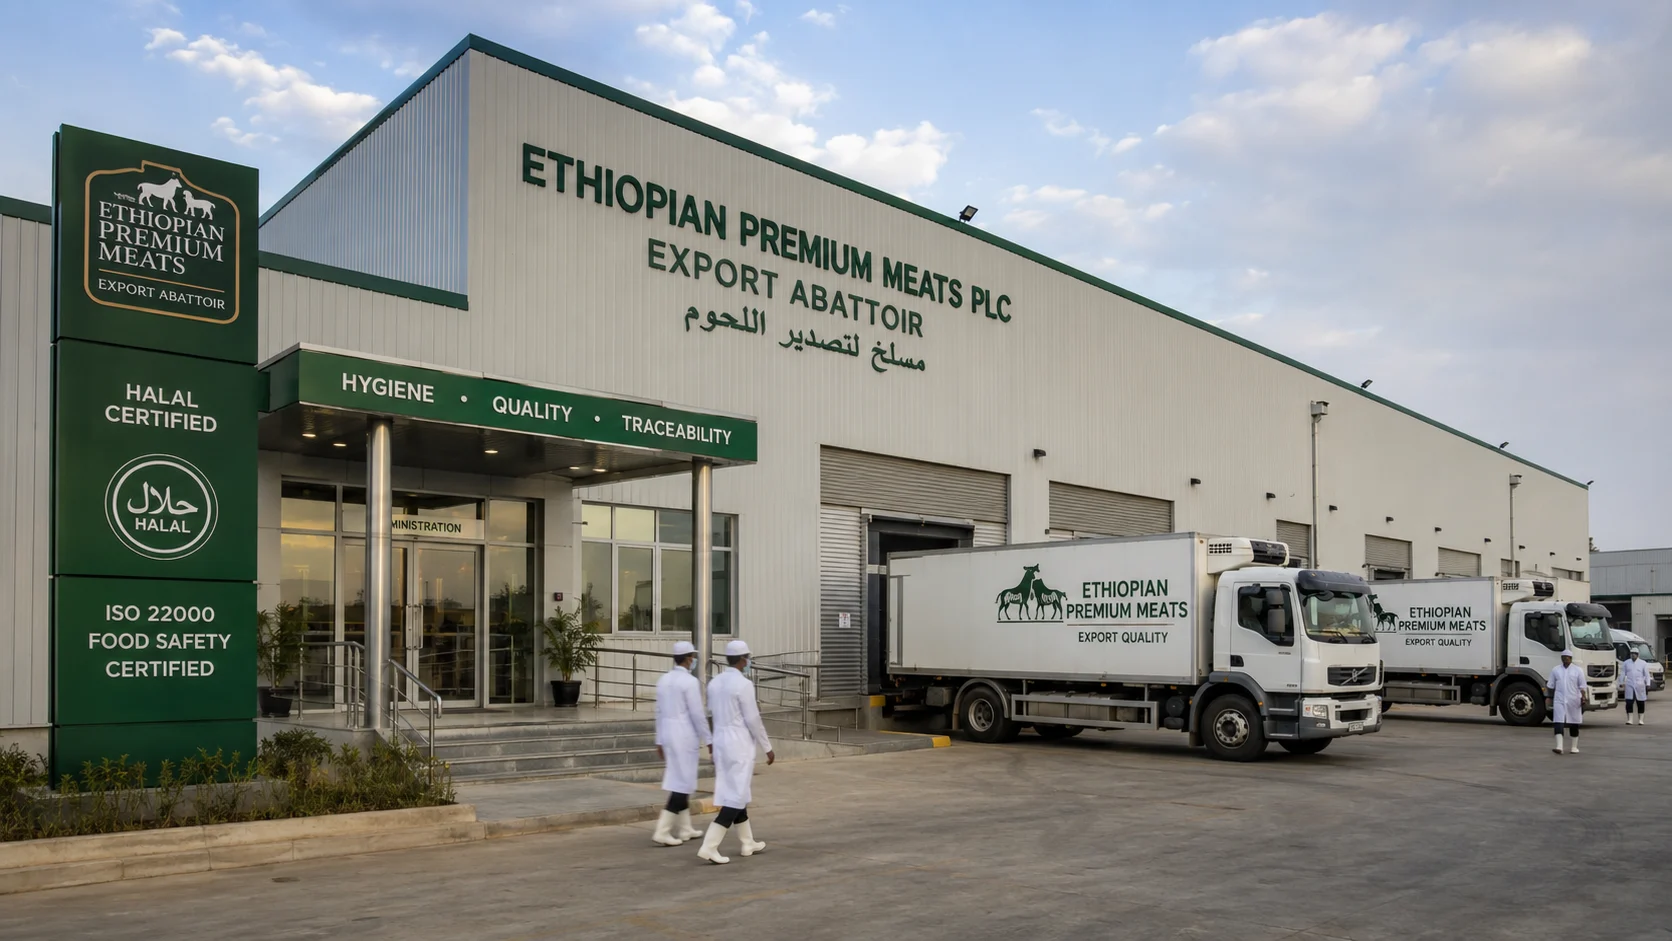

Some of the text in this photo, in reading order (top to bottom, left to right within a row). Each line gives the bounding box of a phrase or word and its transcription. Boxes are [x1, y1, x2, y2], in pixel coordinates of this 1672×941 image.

[99, 200, 225, 242] ETHIOPIAN
[99, 220, 224, 262] PREMIUM
[523, 142, 1012, 323] ETHIOPIAN PREMIUM MEATS PLC
[99, 242, 185, 275] MEATS
[99, 278, 225, 310] EXPORT ABATTOIR
[648, 237, 923, 338] EXPORT ABATTOIR
[684, 306, 926, 373] مسلخ لتصدير اللحوم
[126, 383, 199, 408] HALAL
[105, 405, 217, 433] CERTIFIED
[342, 372, 732, 445] HYGIENE QUALITY TRACEABILITY
[127, 481, 199, 515] حلال
[135, 517, 191, 533] HALAL
[392, 520, 461, 533] MINISTRATION
[1082, 579, 1168, 599] ETHIOPIAN
[106, 604, 215, 622] ISO 22000
[1066, 601, 1188, 619] PREMIUM MEATS
[1409, 606, 1471, 618] ETHIOPIAN
[1399, 620, 1486, 631] PREMIUM MEATS
[88, 632, 231, 650] FOOD SAFETY
[1078, 631, 1168, 643] EXPORT QUALITY
[1405, 638, 1435, 646] EXPORT
[105, 660, 215, 678] CERTIFIED
